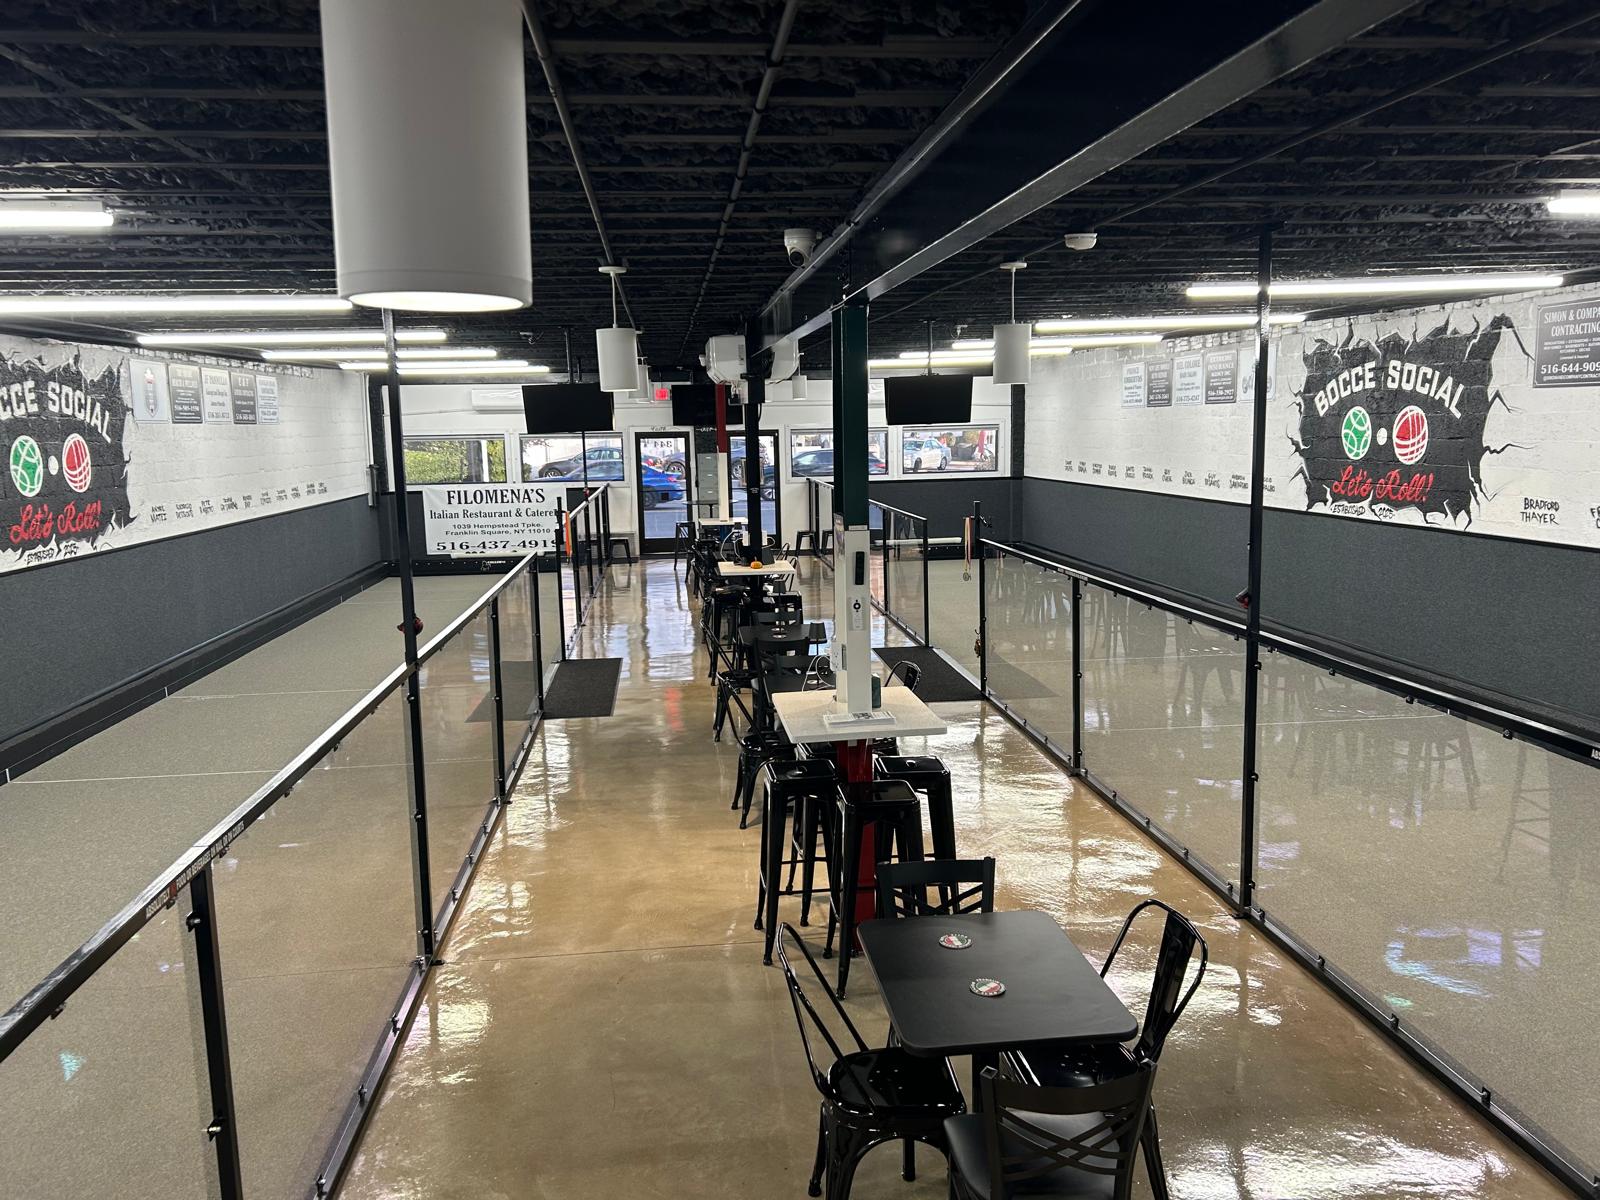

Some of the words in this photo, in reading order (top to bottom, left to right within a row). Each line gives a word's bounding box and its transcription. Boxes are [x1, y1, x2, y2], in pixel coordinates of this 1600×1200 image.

[1544, 310, 1567, 324] SIMON
[1568, 309, 1575, 321] &
[1314, 361, 1376, 417] BOCCE
[1386, 360, 1465, 419] SOCIAL
[48, 381, 111, 444] SOCIAL
[1332, 465, 1372, 498] Let's
[1376, 469, 1434, 502] Roll!
[446, 488, 546, 505] FILOMENA'S
[1523, 497, 1560, 512] BRADFORD
[430, 509, 459, 520] Italian
[462, 508, 512, 519] Restaurant
[515, 508, 523, 518] &
[1520, 511, 1560, 526] THAYER
[10, 504, 53, 544] Let's
[473, 522, 519, 531] Hempstead
